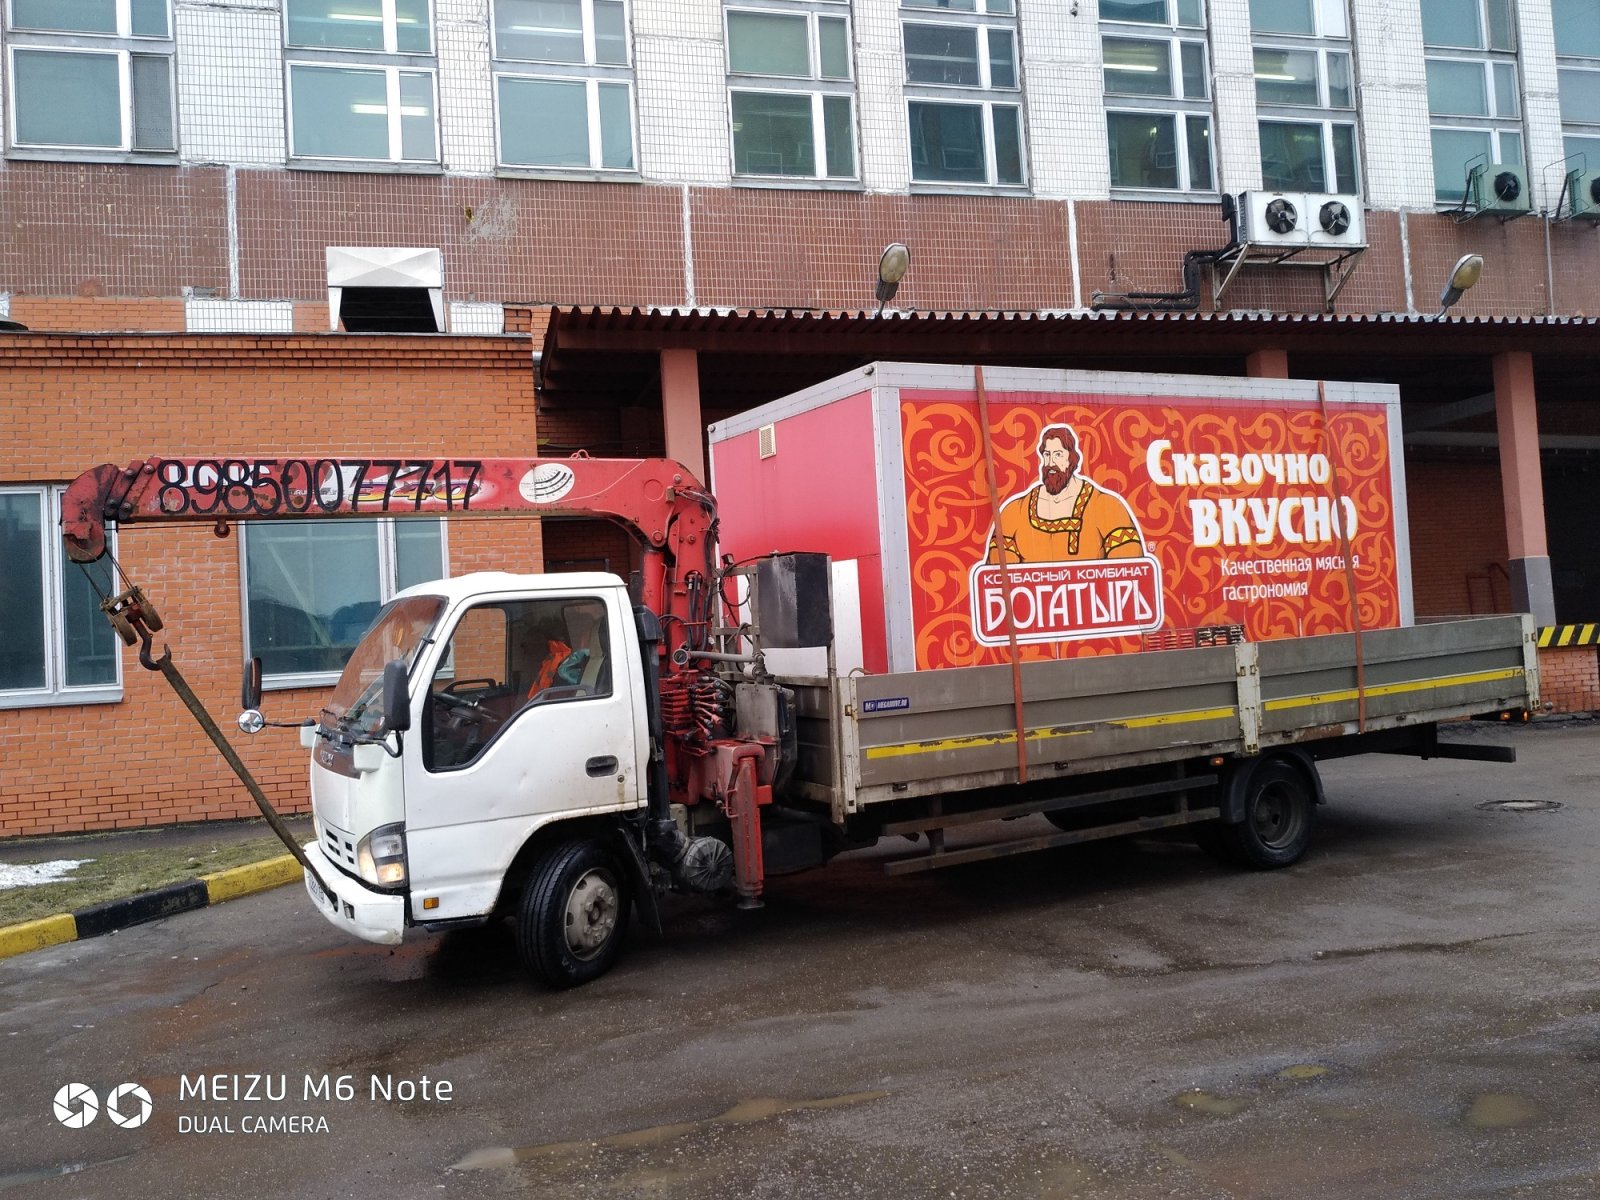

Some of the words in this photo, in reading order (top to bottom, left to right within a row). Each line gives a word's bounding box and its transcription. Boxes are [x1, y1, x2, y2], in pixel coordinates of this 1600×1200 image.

[1146, 439, 1330, 486] Сказочно
[157, 459, 482, 515] 89850077717
[1076, 565, 1150, 580] КОМБИНАТ
[1221, 557, 1313, 576] Качественная
[1315, 554, 1360, 571] мясня
[983, 578, 1153, 632] БОГАТЫРЬ
[1222, 580, 1309, 602] гастрономия
